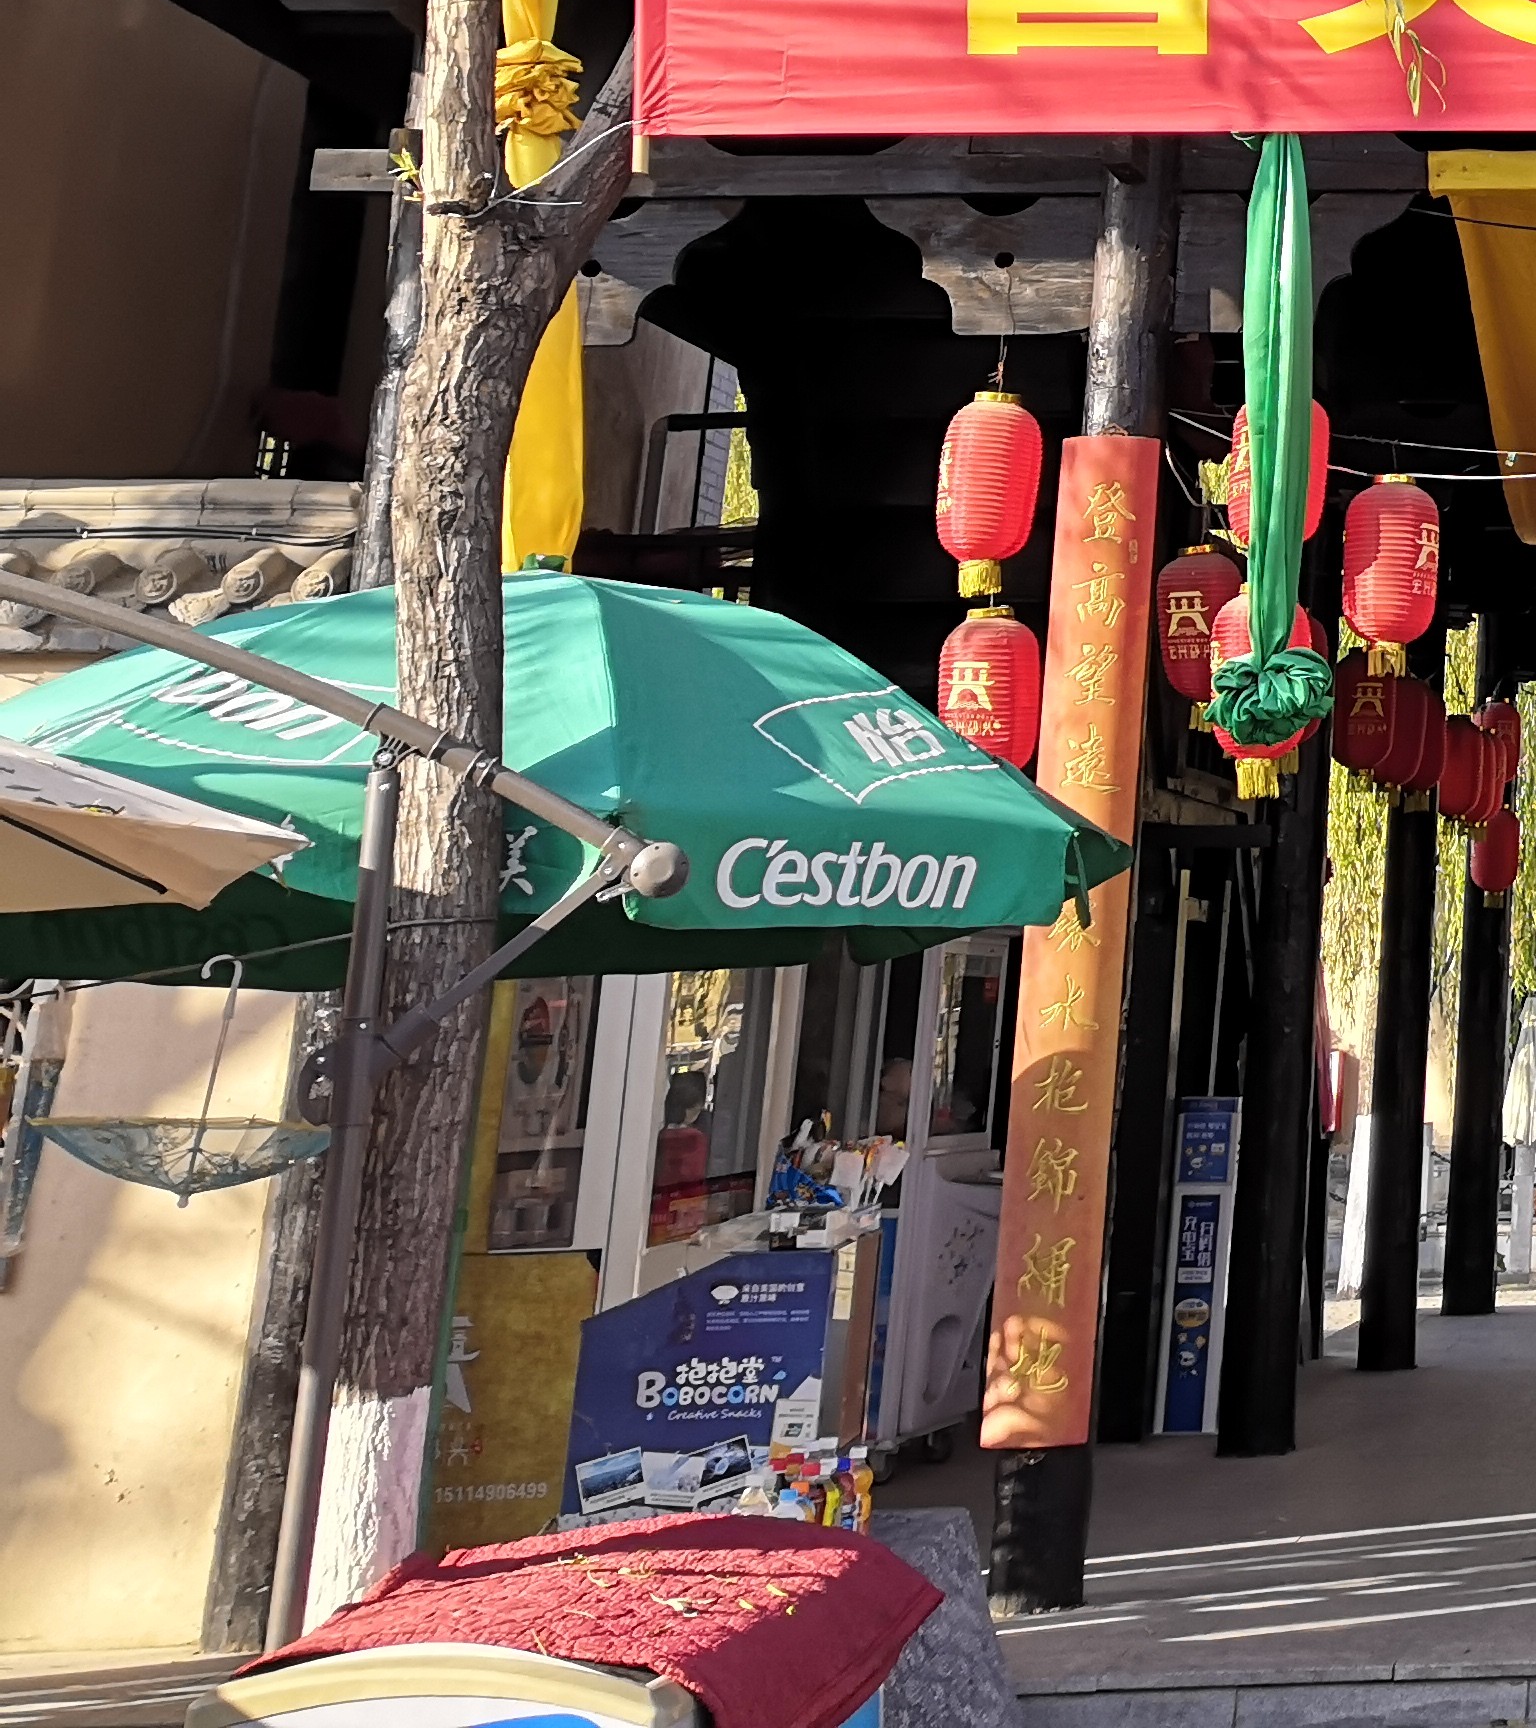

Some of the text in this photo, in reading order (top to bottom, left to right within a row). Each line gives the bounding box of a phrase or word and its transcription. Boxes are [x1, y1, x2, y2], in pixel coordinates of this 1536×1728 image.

[715, 836, 979, 910] C'estbon
[675, 1356, 765, 1385] 抱抱堂
[667, 1408, 763, 1422] Creative Snacks
